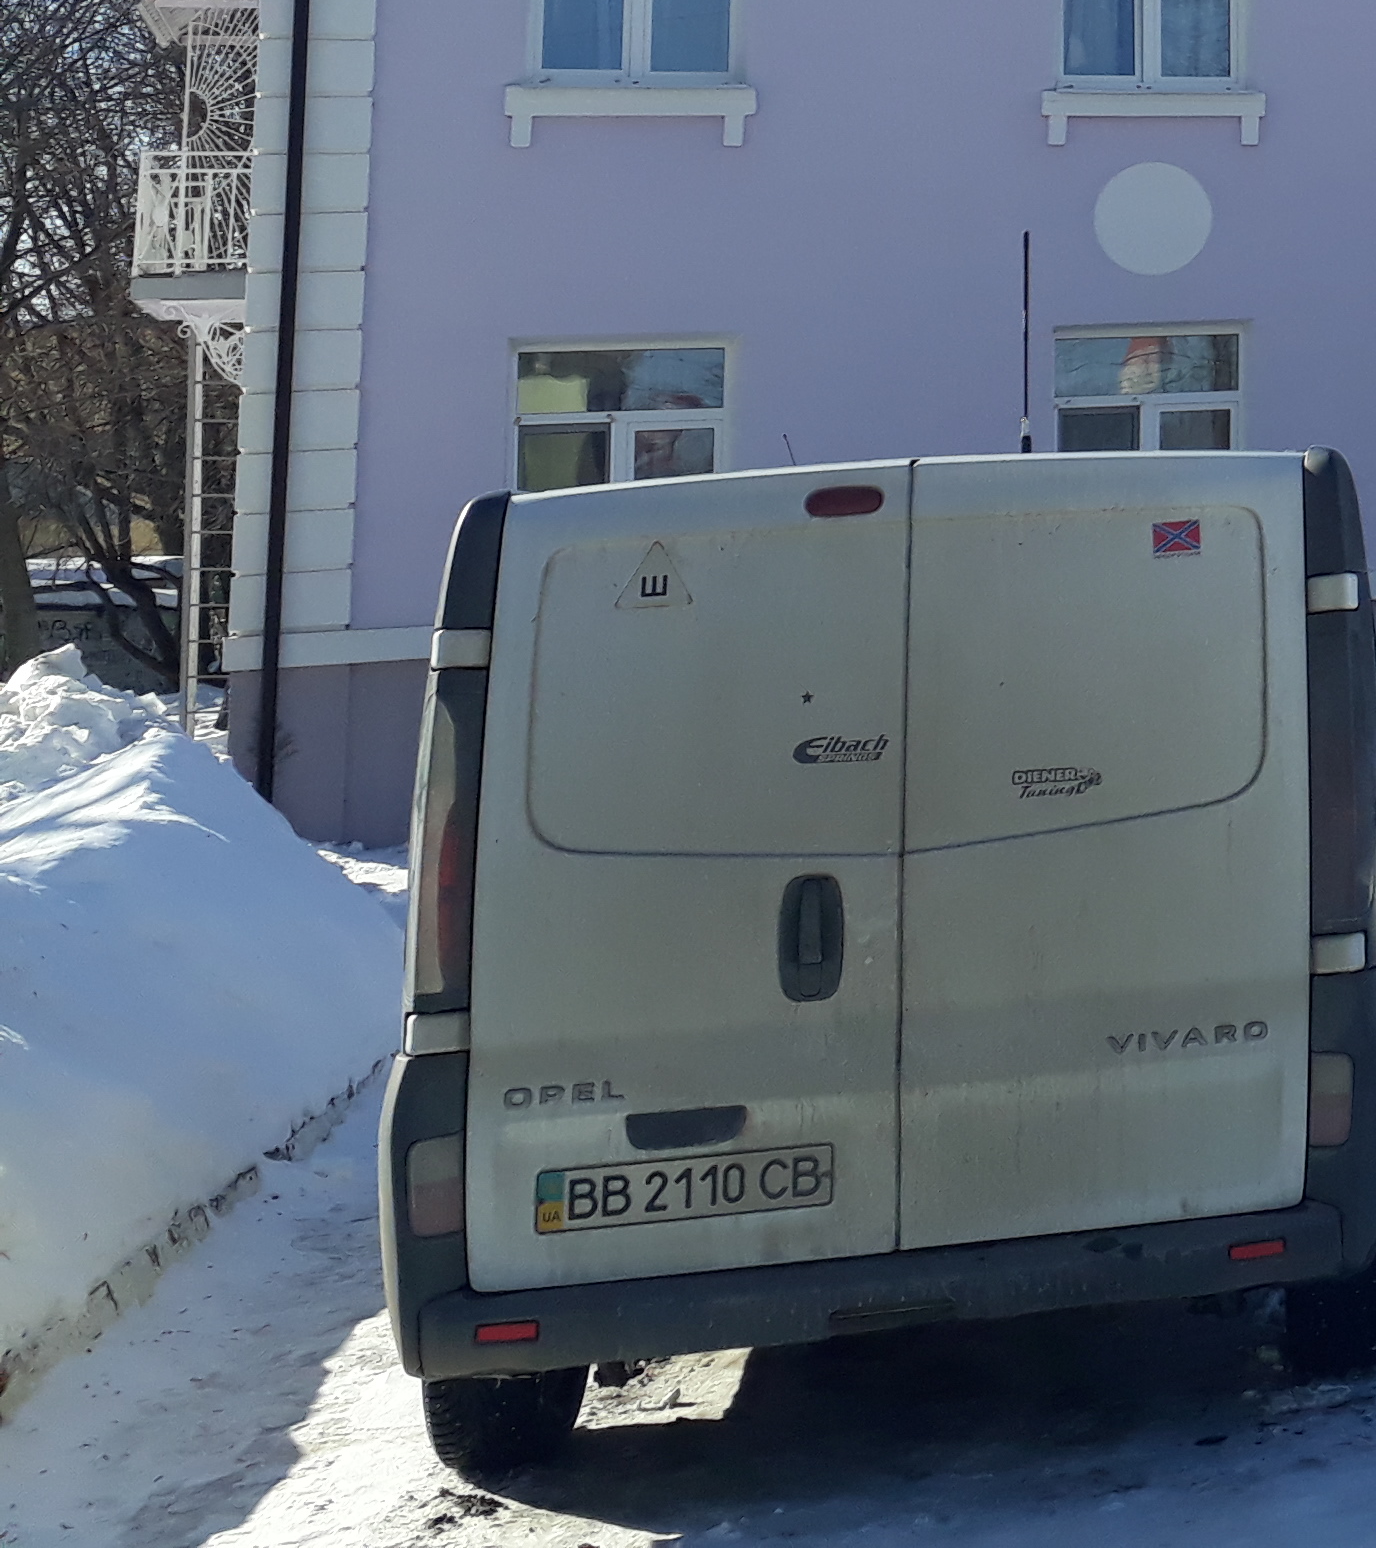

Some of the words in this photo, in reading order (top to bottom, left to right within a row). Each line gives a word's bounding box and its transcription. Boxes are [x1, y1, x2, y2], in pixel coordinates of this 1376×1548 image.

[640, 574, 668, 598] Ш
[792, 733, 890, 764] Eibach
[1012, 767, 1078, 785] DIENER
[1019, 784, 1076, 799] Tuning
[1105, 1020, 1269, 1054] VIVARO
[503, 1079, 626, 1110] OPEL
[567, 1174, 632, 1221] BB
[644, 1163, 746, 1213] 2110
[758, 1155, 822, 1201] CB
[542, 1210, 562, 1223] UA
